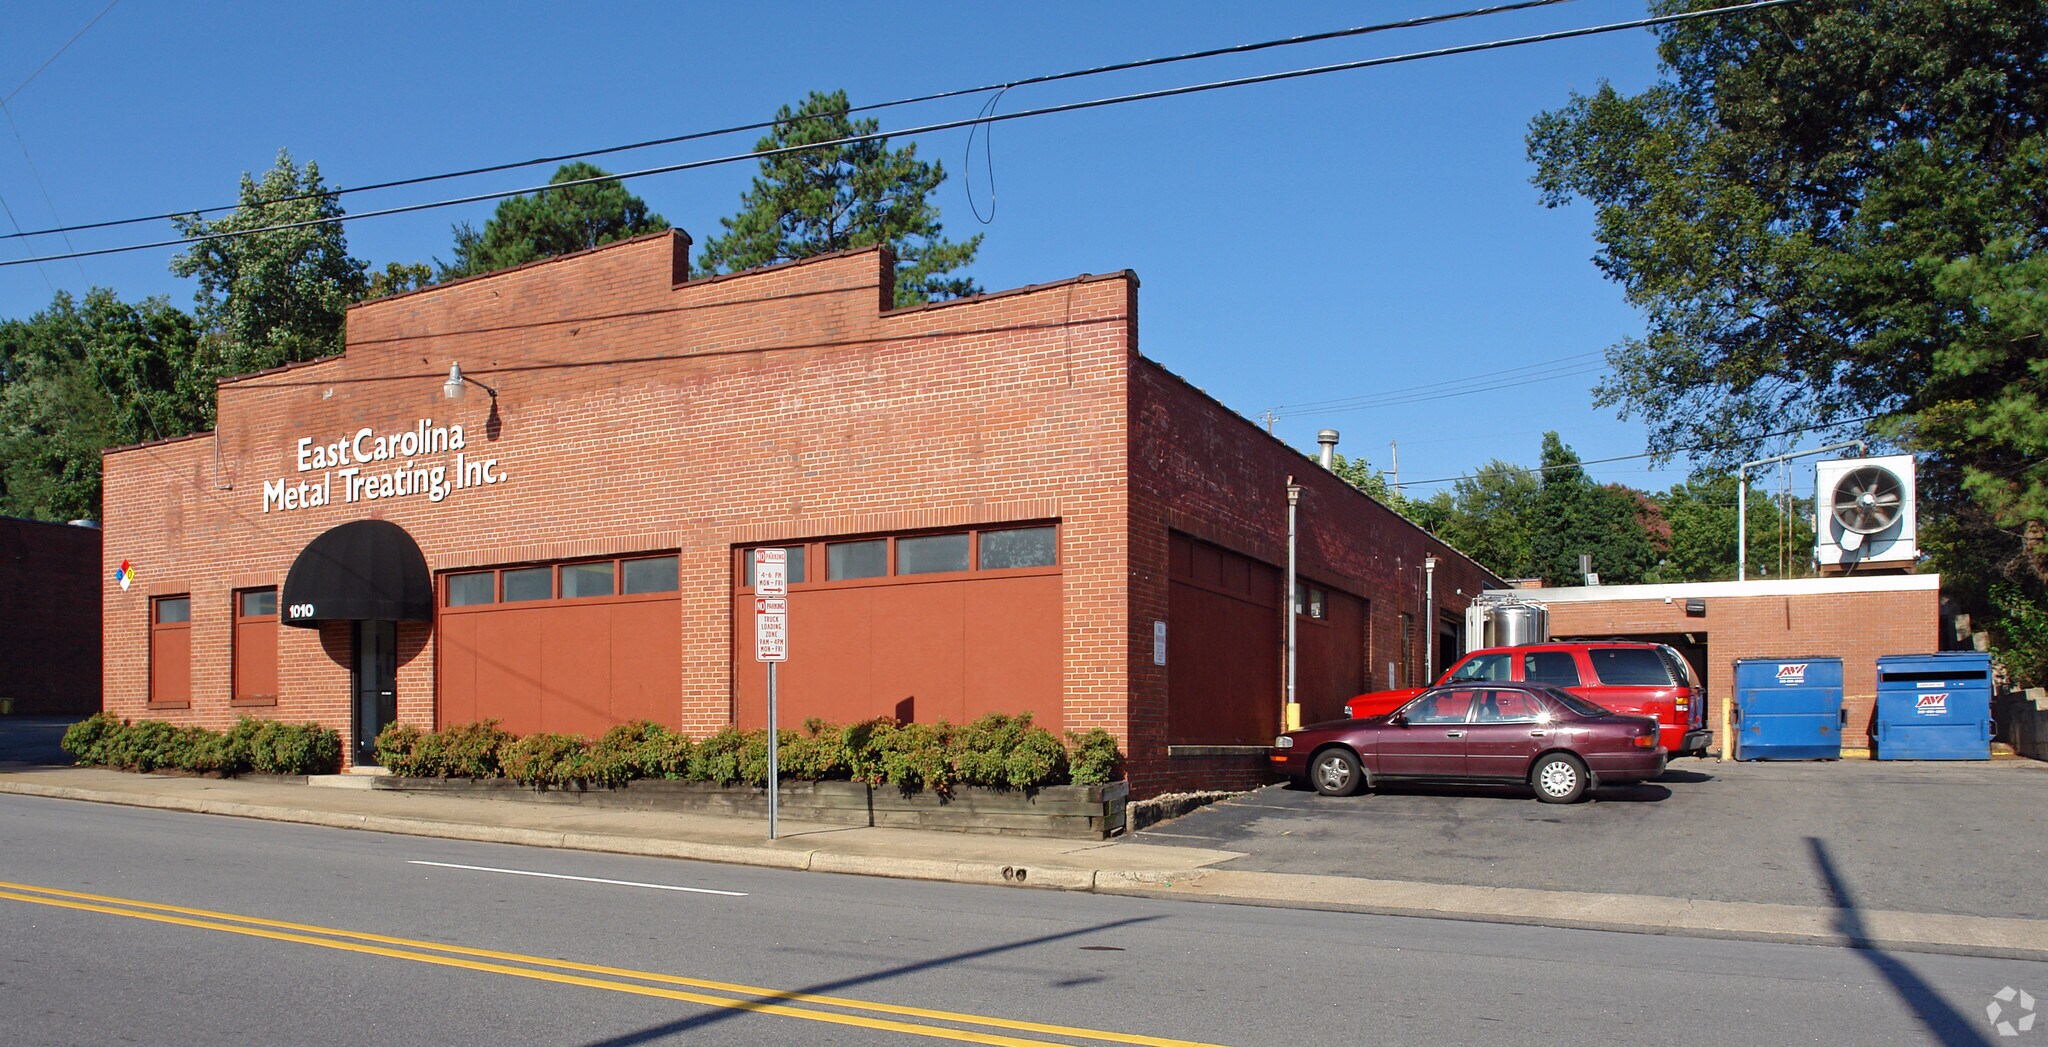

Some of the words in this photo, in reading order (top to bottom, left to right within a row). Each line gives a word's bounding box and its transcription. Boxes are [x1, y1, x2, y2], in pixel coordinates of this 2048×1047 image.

[297, 435, 350, 472] East
[353, 418, 465, 463] Carolina
[263, 471, 330, 512] Metal
[339, 460, 451, 502] Treating,
[456, 453, 508, 489] Inc.
[757, 552, 764, 561] NO
[289, 603, 314, 618] 1010
[757, 602, 765, 610] NO
